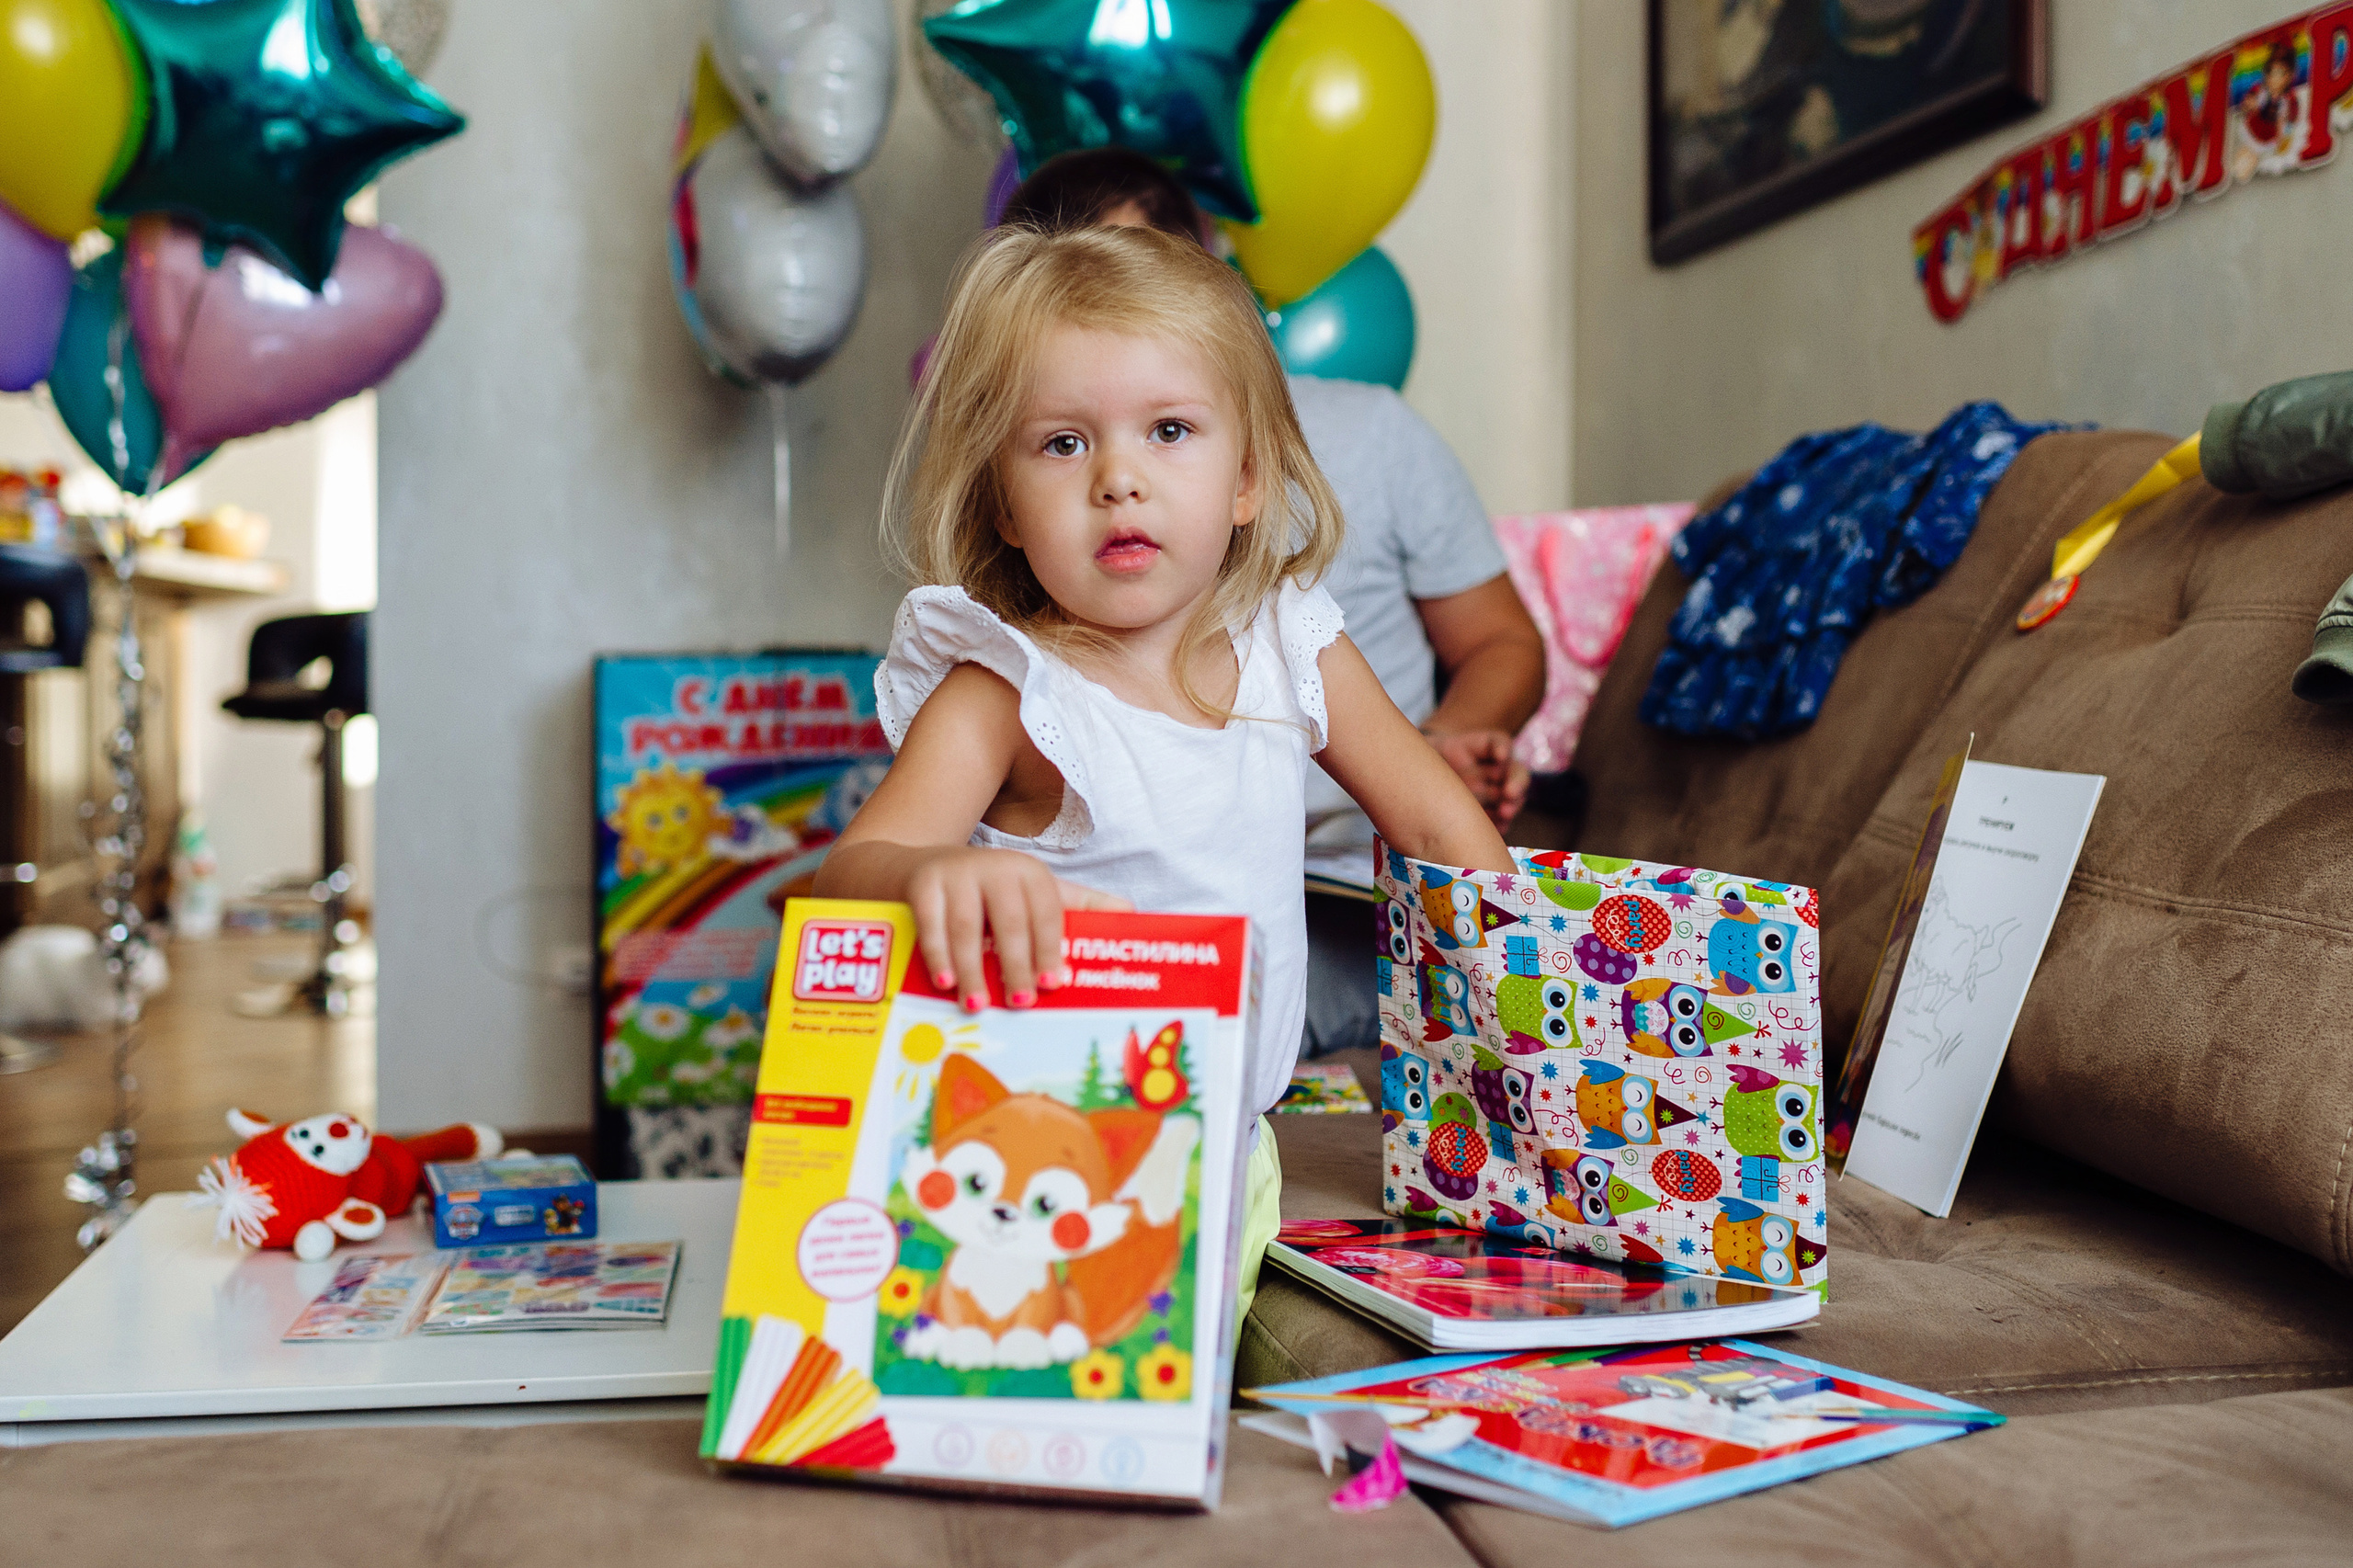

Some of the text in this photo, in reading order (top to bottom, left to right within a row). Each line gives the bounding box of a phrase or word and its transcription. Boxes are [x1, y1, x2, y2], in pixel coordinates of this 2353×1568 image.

[677, 678, 706, 715] С
[1623, 900, 1646, 948] party
[807, 928, 883, 960] Let's
[1072, 937, 1221, 965] ПЛАСТИЛИНА
[802, 959, 879, 998] play
[1450, 1127, 1468, 1172] party
[1675, 1151, 1696, 1193] party
